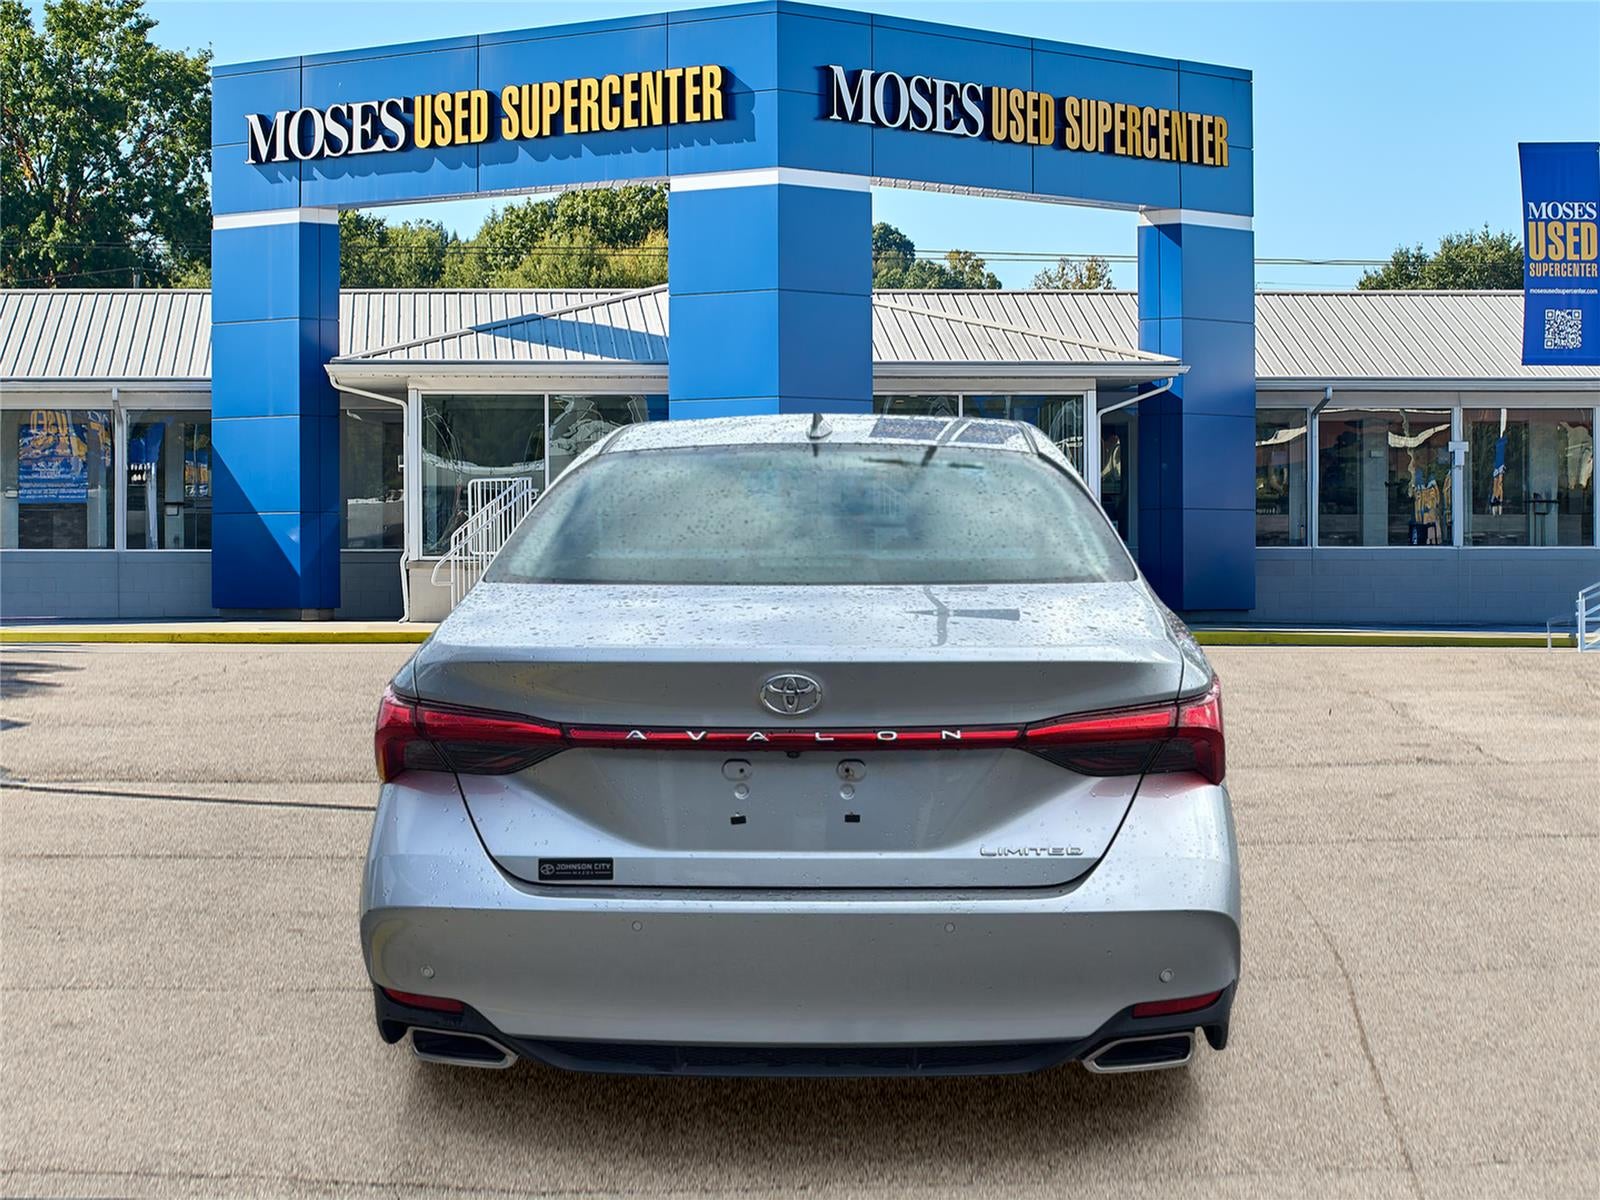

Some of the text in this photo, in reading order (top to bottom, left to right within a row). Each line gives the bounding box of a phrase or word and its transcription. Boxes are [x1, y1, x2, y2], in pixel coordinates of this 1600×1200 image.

[244, 64, 724, 165] MOSES USED SUPERCENTER
[829, 65, 1229, 167] MOSES USED SUPERCENTER
[1527, 201, 1598, 220] MOSES
[1528, 221, 1598, 261] USED
[1529, 262, 1598, 278] SUPERCENTER
[625, 729, 962, 742] AVALON
[979, 846, 1084, 857] LIMITED
